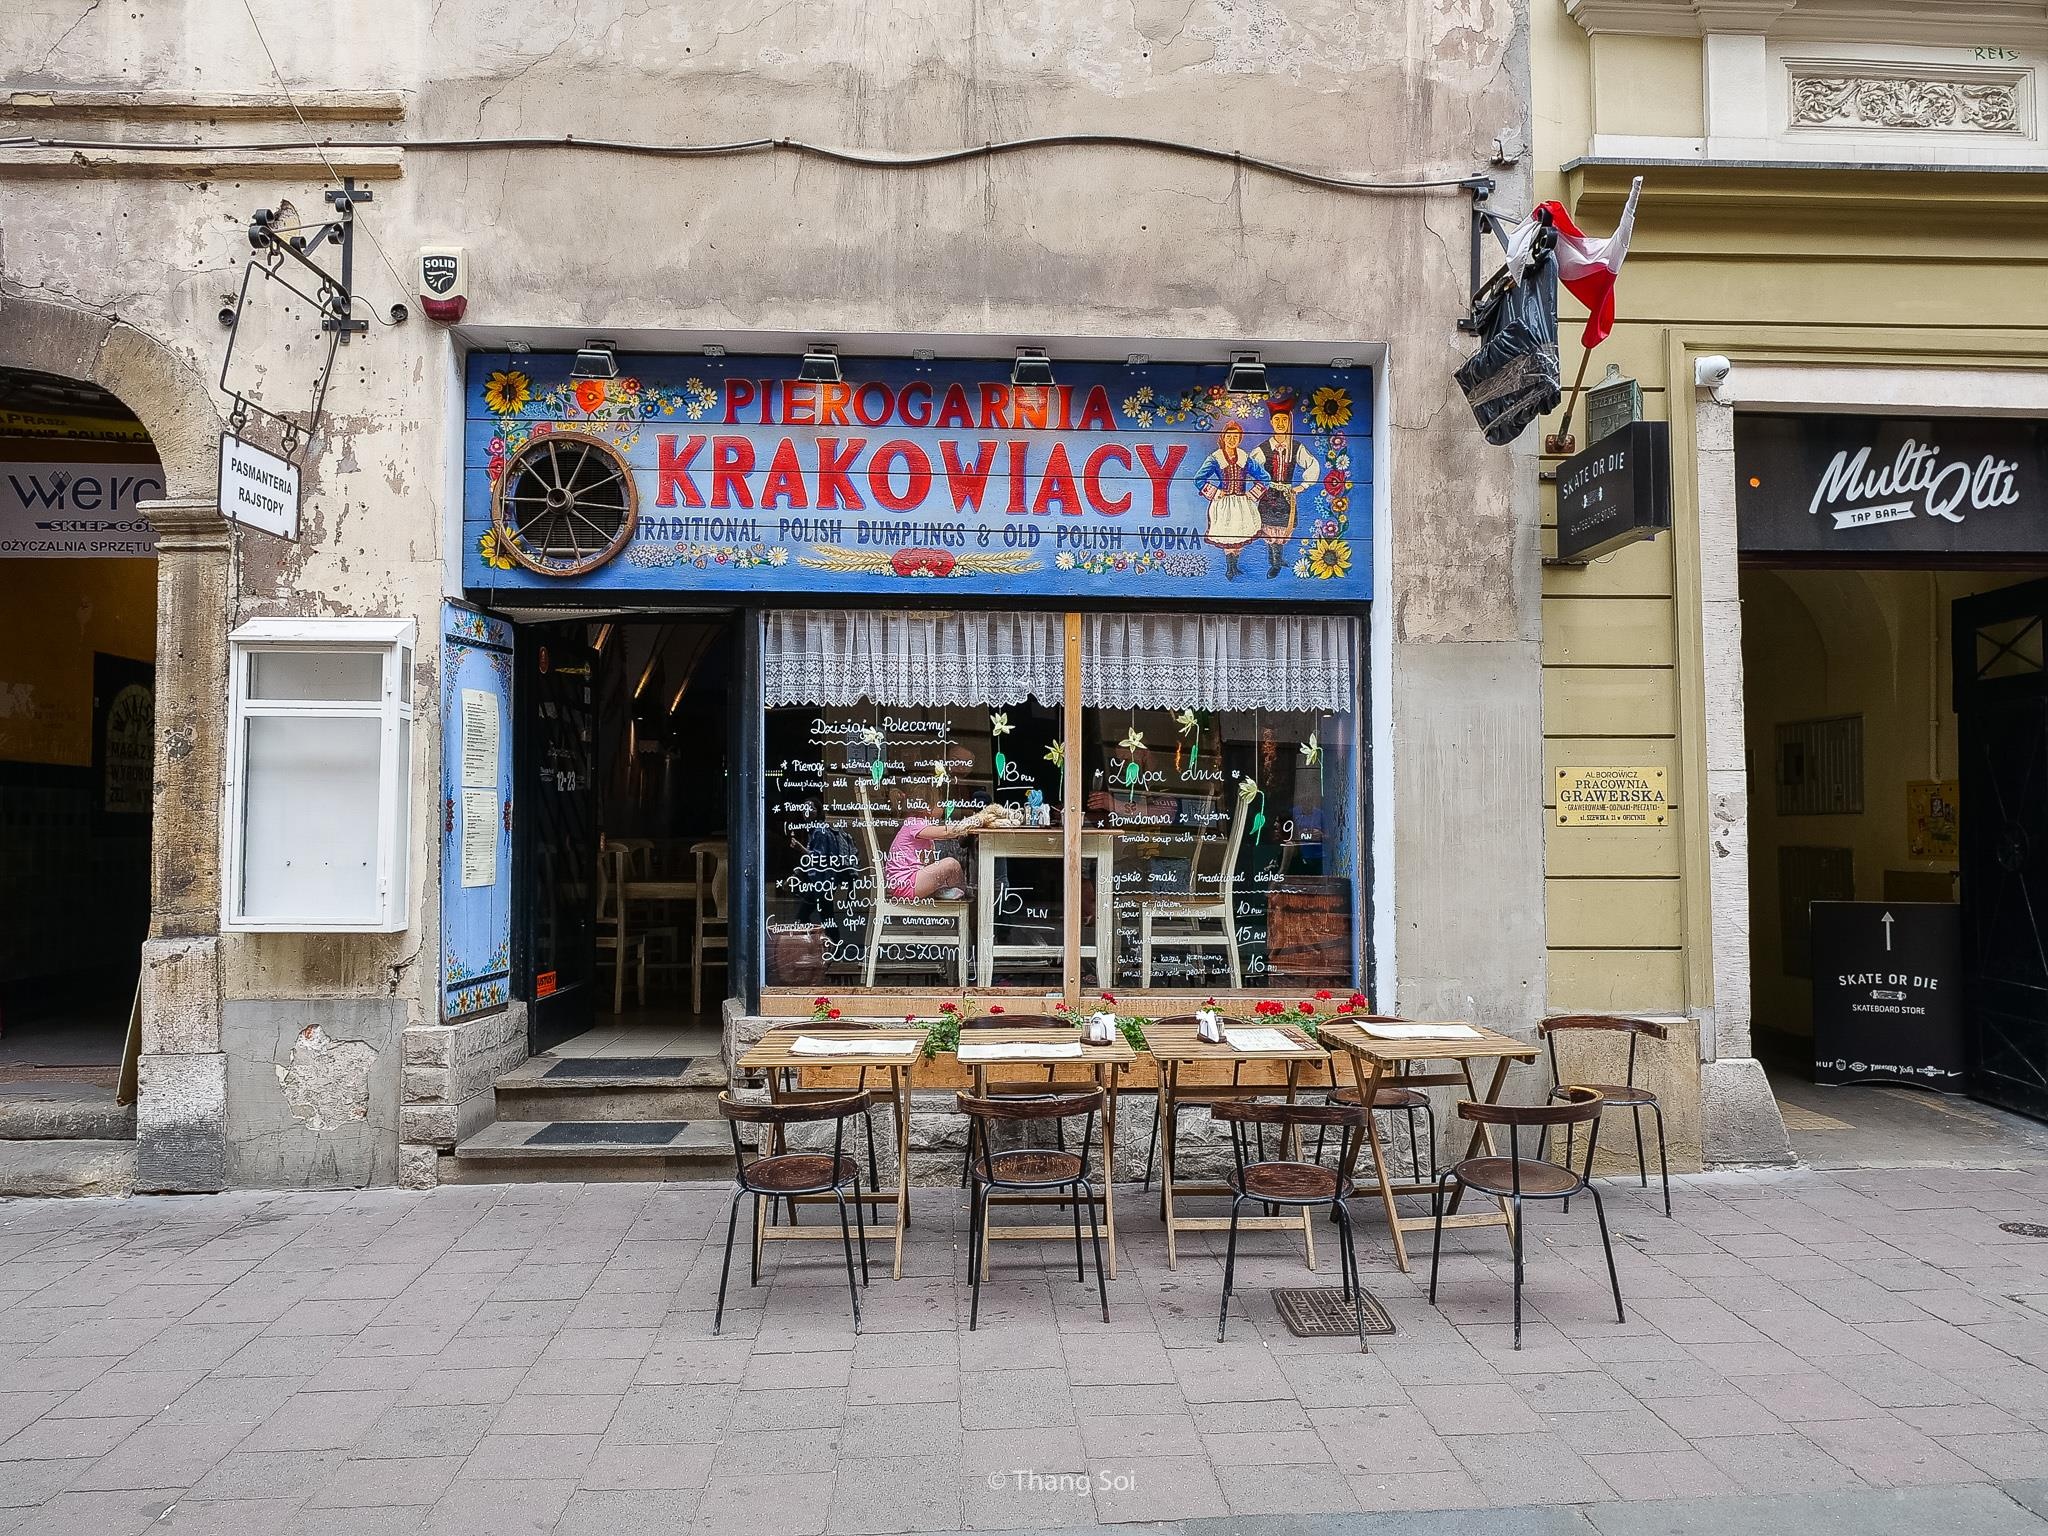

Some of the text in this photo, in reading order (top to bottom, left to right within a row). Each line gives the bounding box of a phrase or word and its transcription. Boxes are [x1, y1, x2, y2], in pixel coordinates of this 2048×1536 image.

[425, 259, 455, 268] SOLID
[723, 378, 1118, 430] PIEROGARNIA
[231, 457, 293, 496] PASMANTERIA
[655, 433, 1189, 517] KRAKOWIACY
[1563, 452, 1625, 499] SKATE OR DIE
[238, 486, 285, 516] RAJSTOPY
[1851, 508, 1898, 523] TAP BAR
[50, 519, 109, 532] SKLEP
[634, 516, 1201, 550] TRADITIONAL POLISH DUMPLINGS & OLD POLISH VODKA
[90, 541, 150, 554] SPRZĘTU
[811, 716, 951, 739] Dzisiaj Polecamy:
[792, 760, 825, 777] Pierogi
[832, 778, 848, 787] with
[1575, 780, 1649, 789] PRACOWNIA
[1560, 790, 1666, 802] GRAWERSKA
[784, 802, 814, 818] Pierogi
[832, 819, 848, 828] with
[1108, 811, 1173, 828] Pomidorowa
[1151, 836, 1172, 846] soup
[1174, 831, 1194, 843] with
[1282, 820, 1294, 842] 9
[800, 855, 859, 867] OFERTA
[1147, 870, 1178, 883] smaki
[1253, 870, 1285, 883] dishes
[786, 876, 838, 901] Pierogi
[816, 898, 823, 913] i
[992, 882, 1049, 919] 15 PLN
[1236, 900, 1251, 915] 10
[842, 916, 867, 932] apple
[1235, 925, 1253, 942] 15
[1247, 953, 1266, 974] 16
[1838, 973, 1939, 990] SKATE OR DIE
[1852, 1004, 1926, 1015] SKATEBOARD STORE
